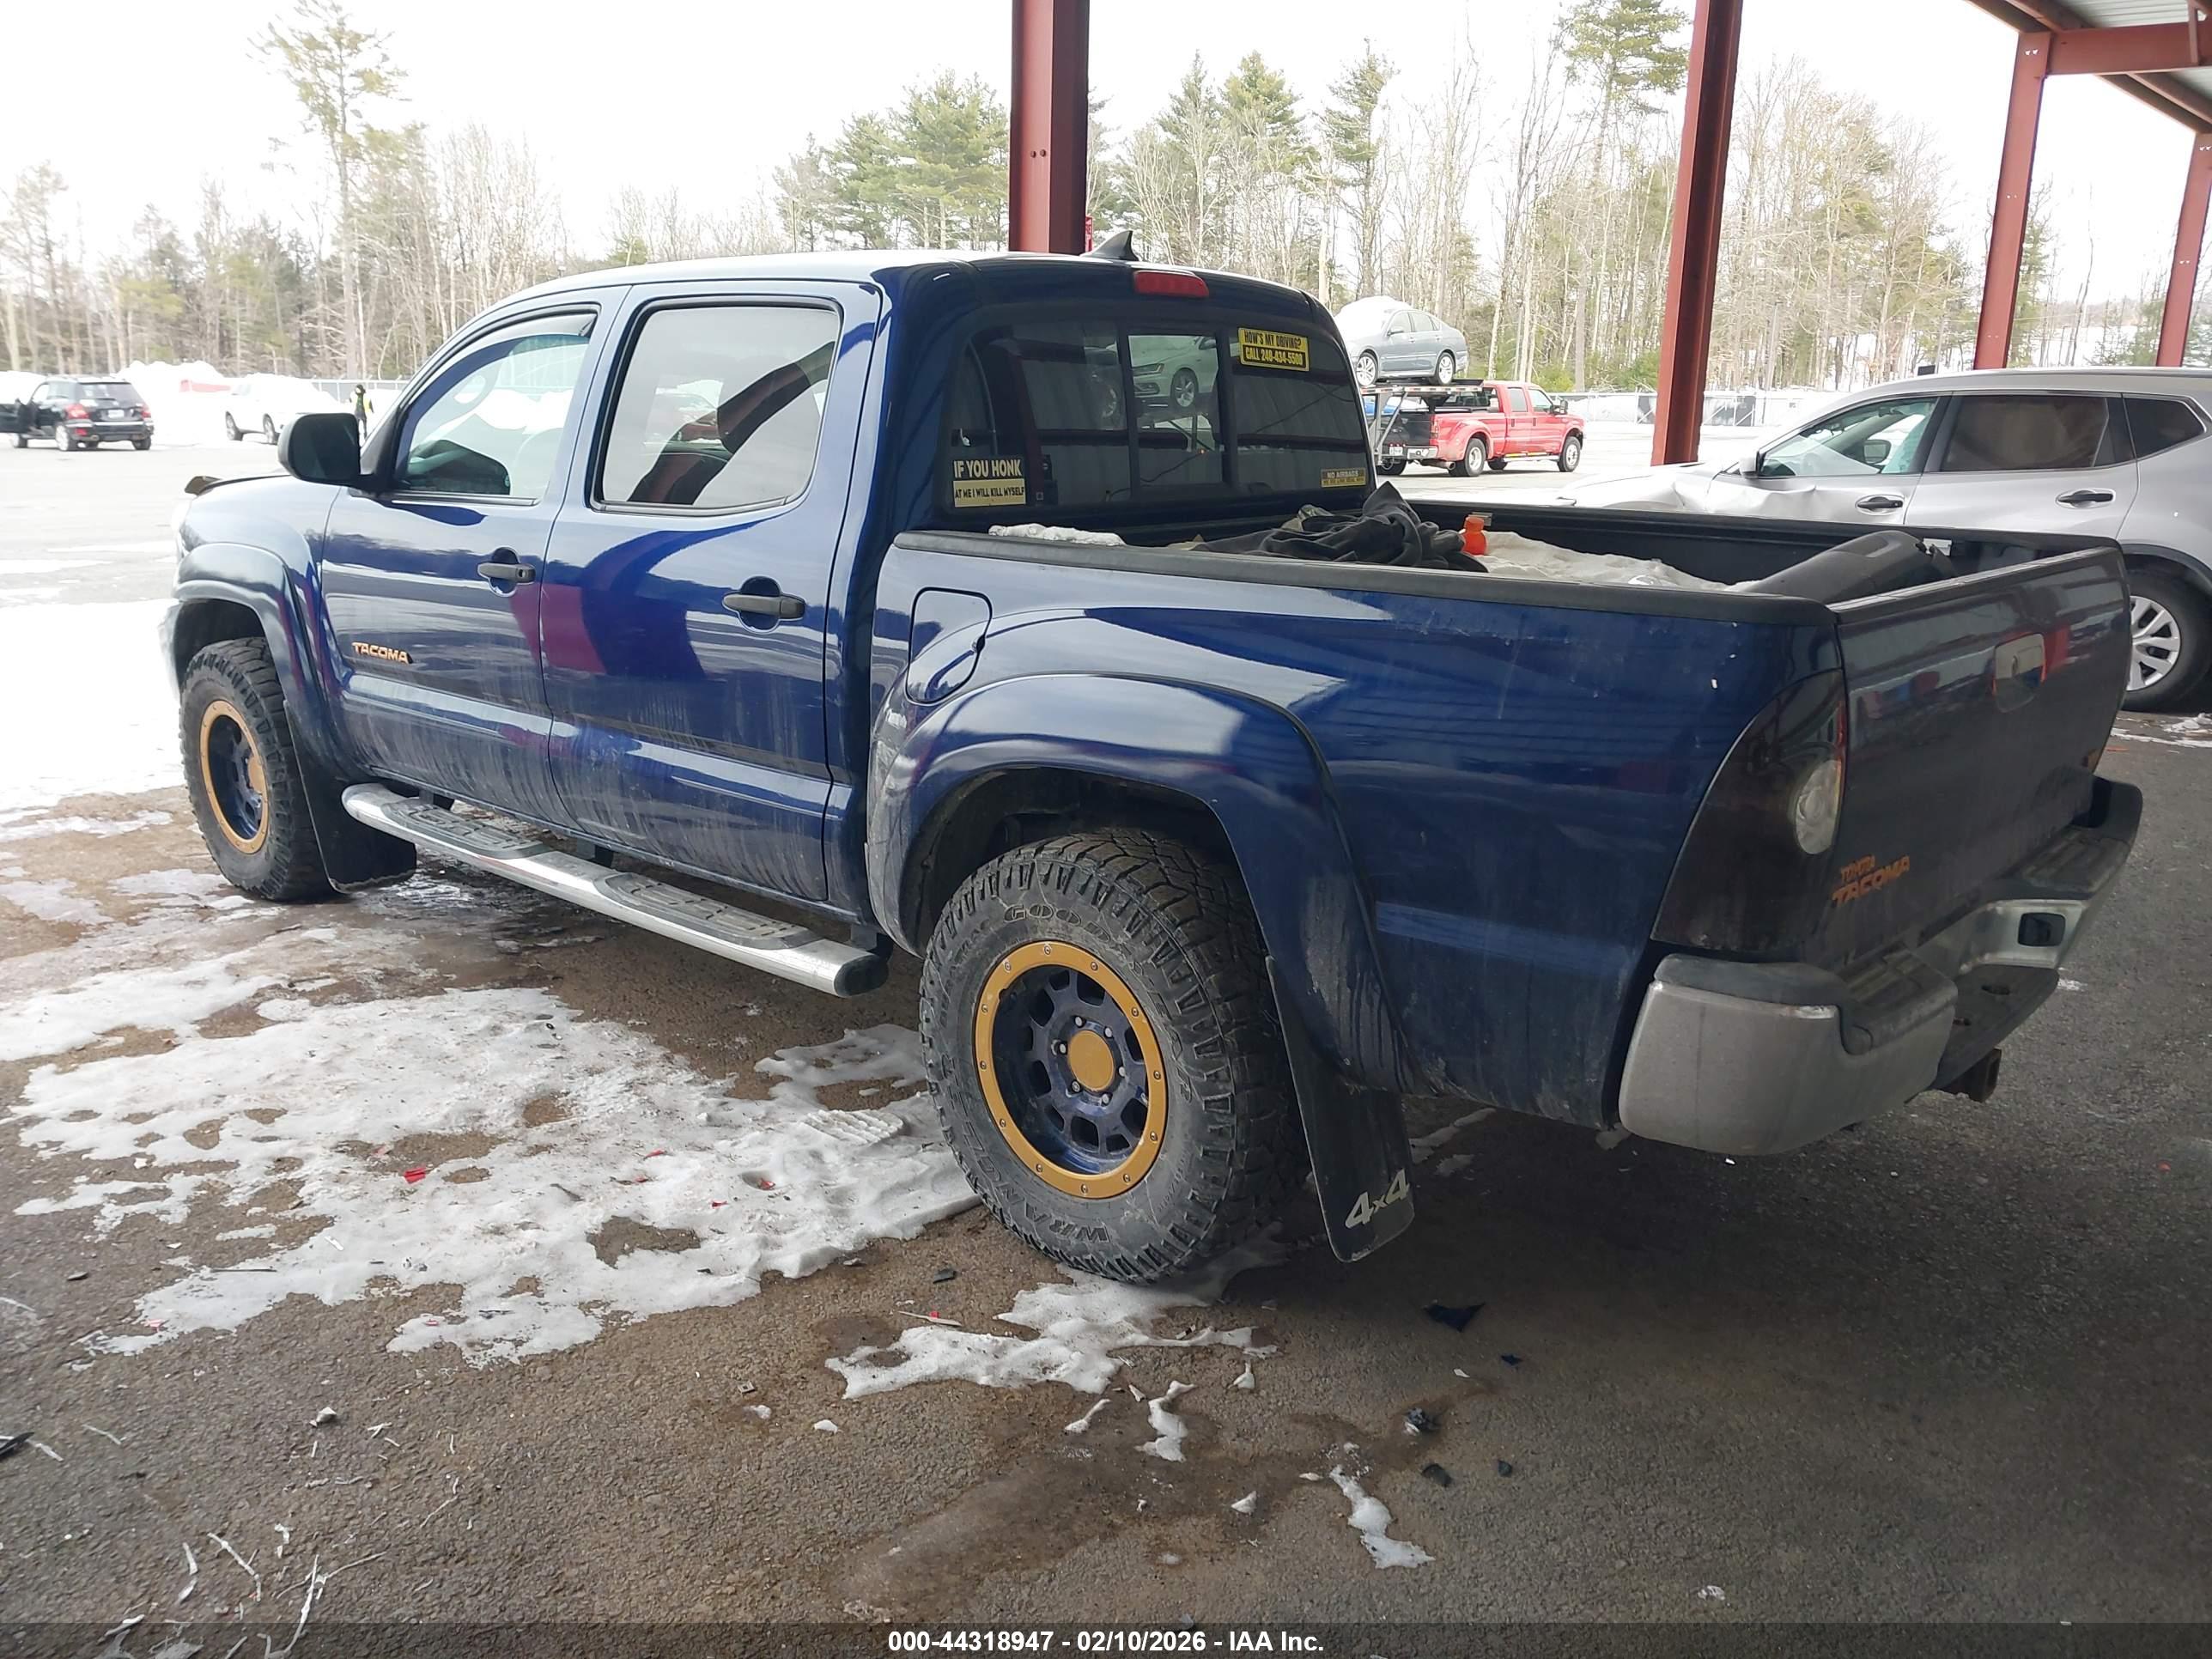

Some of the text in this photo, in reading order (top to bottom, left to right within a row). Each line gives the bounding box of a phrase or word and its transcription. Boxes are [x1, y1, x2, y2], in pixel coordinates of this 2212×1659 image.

[1244, 330, 1302, 349] HOW'S MY DRIVING?
[1246, 347, 1261, 361] CALL
[954, 459, 1022, 478] IF YOU HONK
[955, 489, 963, 499] AT
[963, 489, 971, 498] ME
[976, 488, 990, 497] WILL
[990, 487, 1003, 497] KILL
[1004, 486, 1024, 496] MYSELF
[351, 642, 410, 664] TACOMA
[1832, 855, 1911, 908] TACOMA
[1345, 1168, 1411, 1229] 4x4
